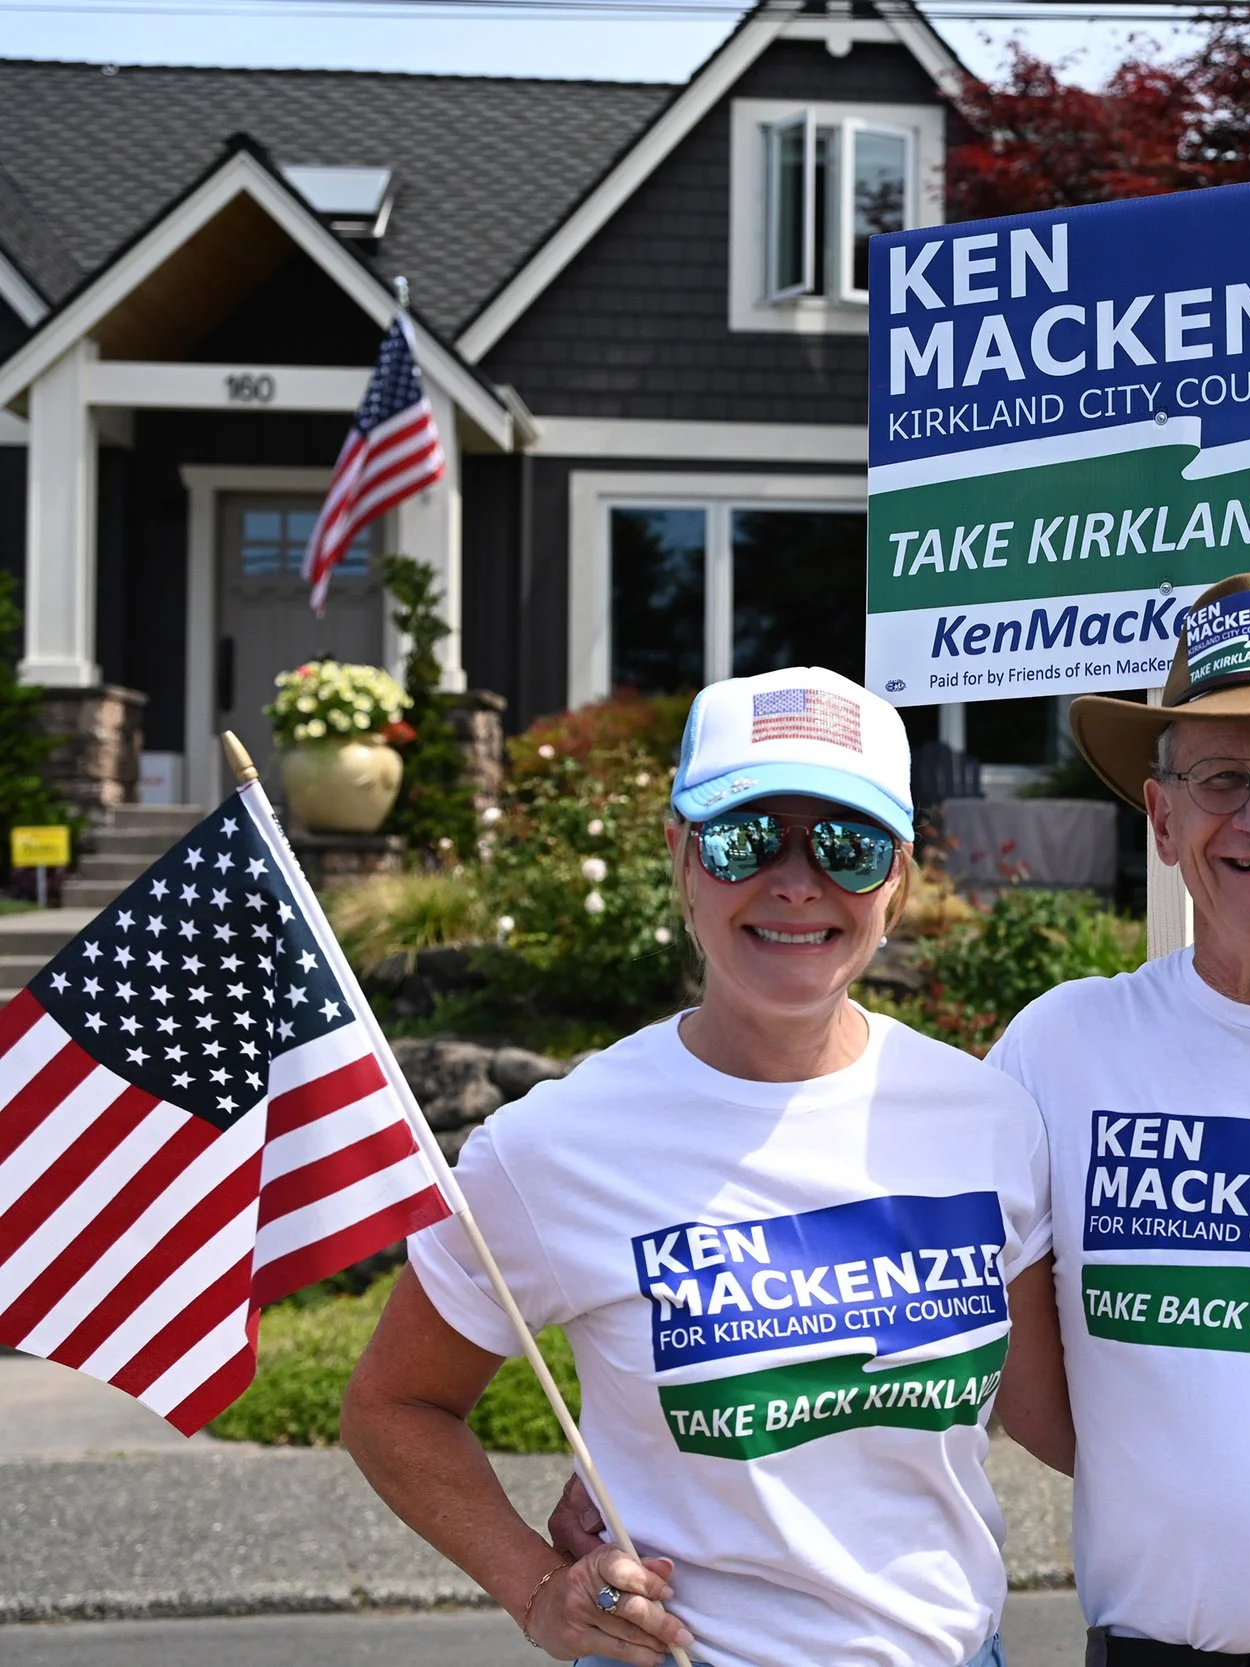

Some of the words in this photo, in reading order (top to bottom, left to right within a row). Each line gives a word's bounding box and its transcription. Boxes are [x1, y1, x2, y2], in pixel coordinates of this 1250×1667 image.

[890, 222, 1069, 315] KEN
[226, 373, 276, 402] 160
[889, 394, 1065, 441] KIRKLAND
[1079, 381, 1163, 419] CITY
[888, 521, 1015, 577] TAKE
[1186, 601, 1221, 631] KEN
[1187, 636, 1221, 656] KIRKLAND
[1221, 630, 1240, 640] CITY
[929, 672, 959, 689] Paid
[962, 671, 984, 686] for
[987, 669, 1005, 686] by
[1008, 664, 1061, 682] Friends
[1064, 662, 1081, 678] of
[1084, 661, 1111, 677] Ken
[1190, 662, 1212, 683] TAKE
[1096, 1115, 1205, 1162] KEN
[641, 1225, 772, 1278] KEN
[1089, 1215, 1125, 1234] FOR
[1131, 1217, 1241, 1242] KIRKLAND
[648, 1244, 1002, 1323] MACKENZIE
[659, 1327, 706, 1351] FOR
[713, 1313, 837, 1343] KIRKLAND
[843, 1305, 899, 1330] CITY
[904, 1295, 996, 1322] COUNCIL
[1085, 1288, 1152, 1322] TAKE
[1157, 1295, 1250, 1330] BACK
[669, 1404, 756, 1439] TAKE
[765, 1388, 855, 1432] BACK
